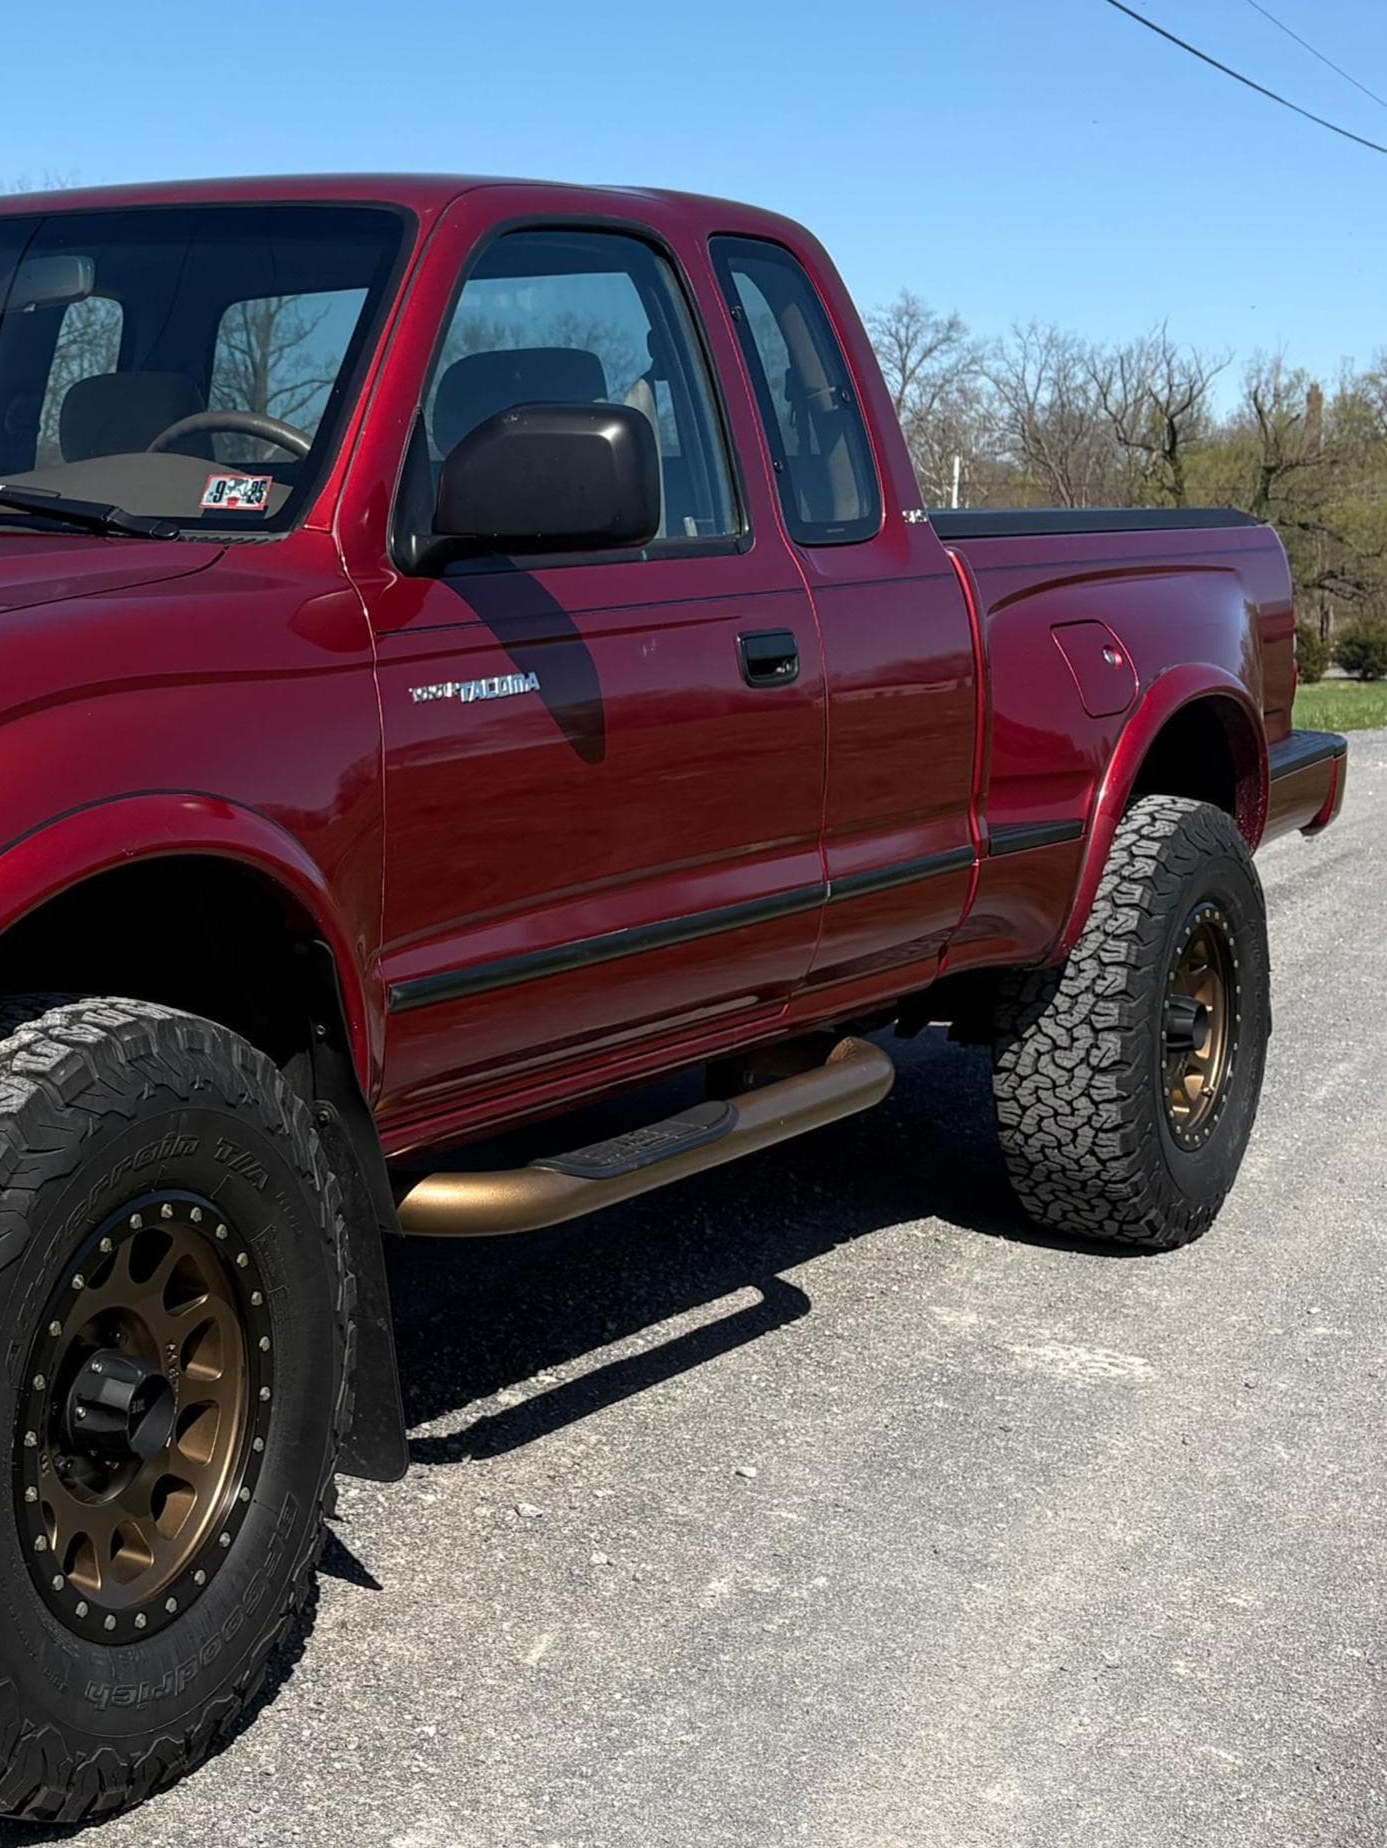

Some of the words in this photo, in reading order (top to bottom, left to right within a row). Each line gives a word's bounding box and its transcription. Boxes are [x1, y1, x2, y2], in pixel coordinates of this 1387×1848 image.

[213, 480, 226, 503] 9
[247, 480, 267, 504] 25
[459, 671, 540, 702] TACOMA
